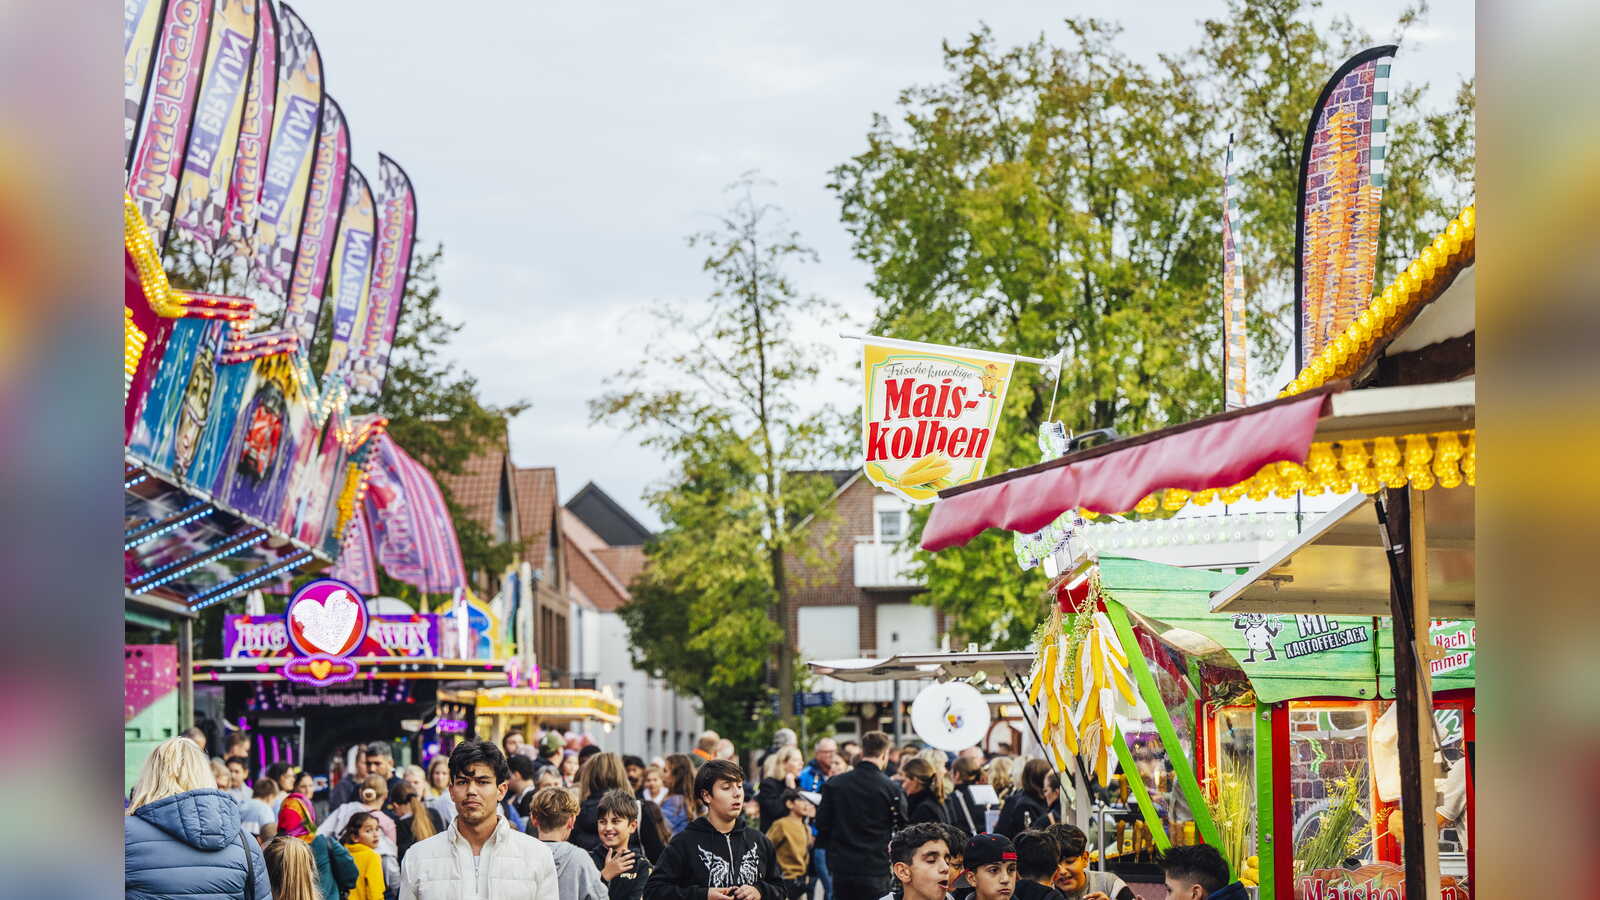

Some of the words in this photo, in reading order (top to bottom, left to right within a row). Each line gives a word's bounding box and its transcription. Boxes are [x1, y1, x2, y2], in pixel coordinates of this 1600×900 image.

[883, 378, 980, 422] Mais-
[866, 420, 990, 462] kolben
[238, 623, 290, 650] BIG
[376, 622, 430, 650] WIN
[1284, 626, 1368, 659] KARTOFFELSACK
[1435, 631, 1466, 648] Nach
[1430, 652, 1469, 673] mmer
